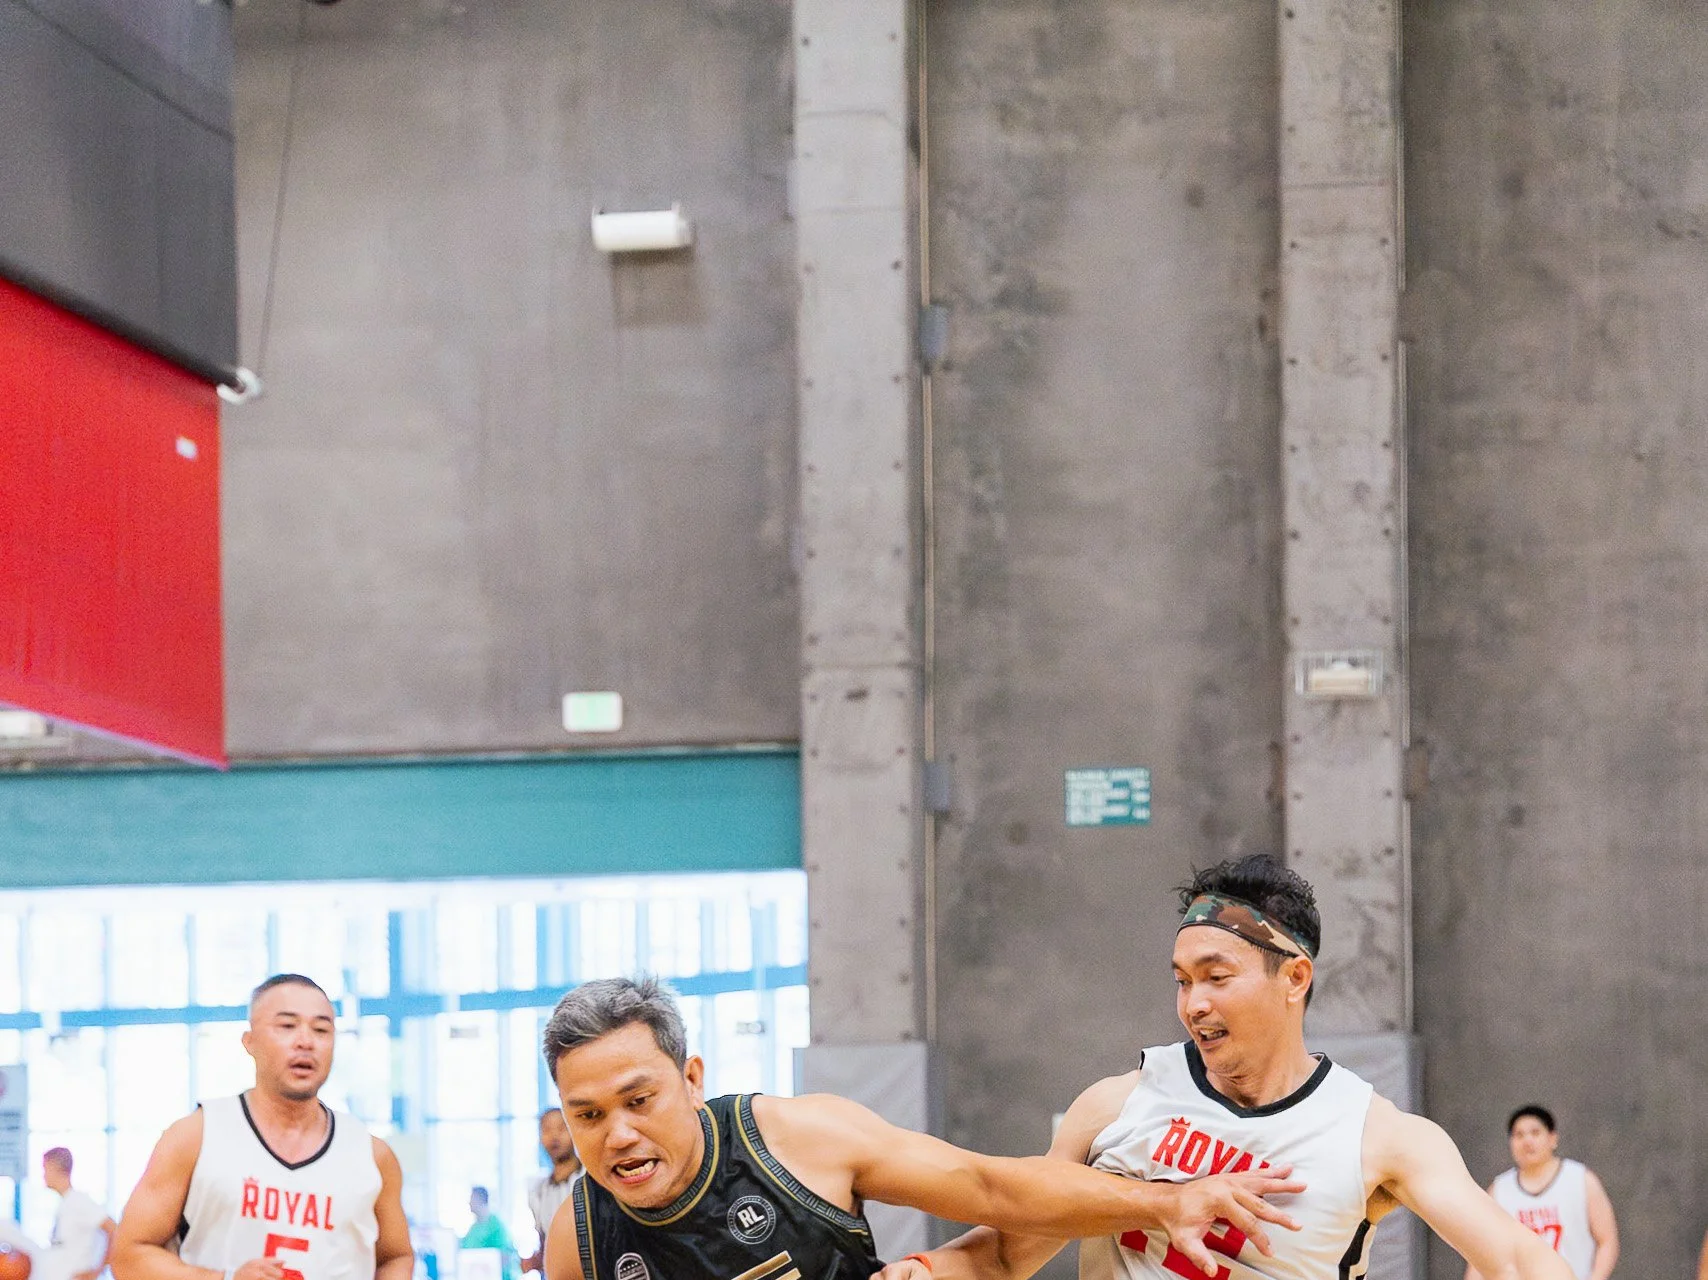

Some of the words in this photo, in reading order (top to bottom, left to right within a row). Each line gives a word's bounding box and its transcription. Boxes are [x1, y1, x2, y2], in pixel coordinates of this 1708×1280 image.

[1152, 1124, 1271, 1175] ROYA
[241, 1181, 334, 1230] ROYAL
[737, 1205, 765, 1228] RL
